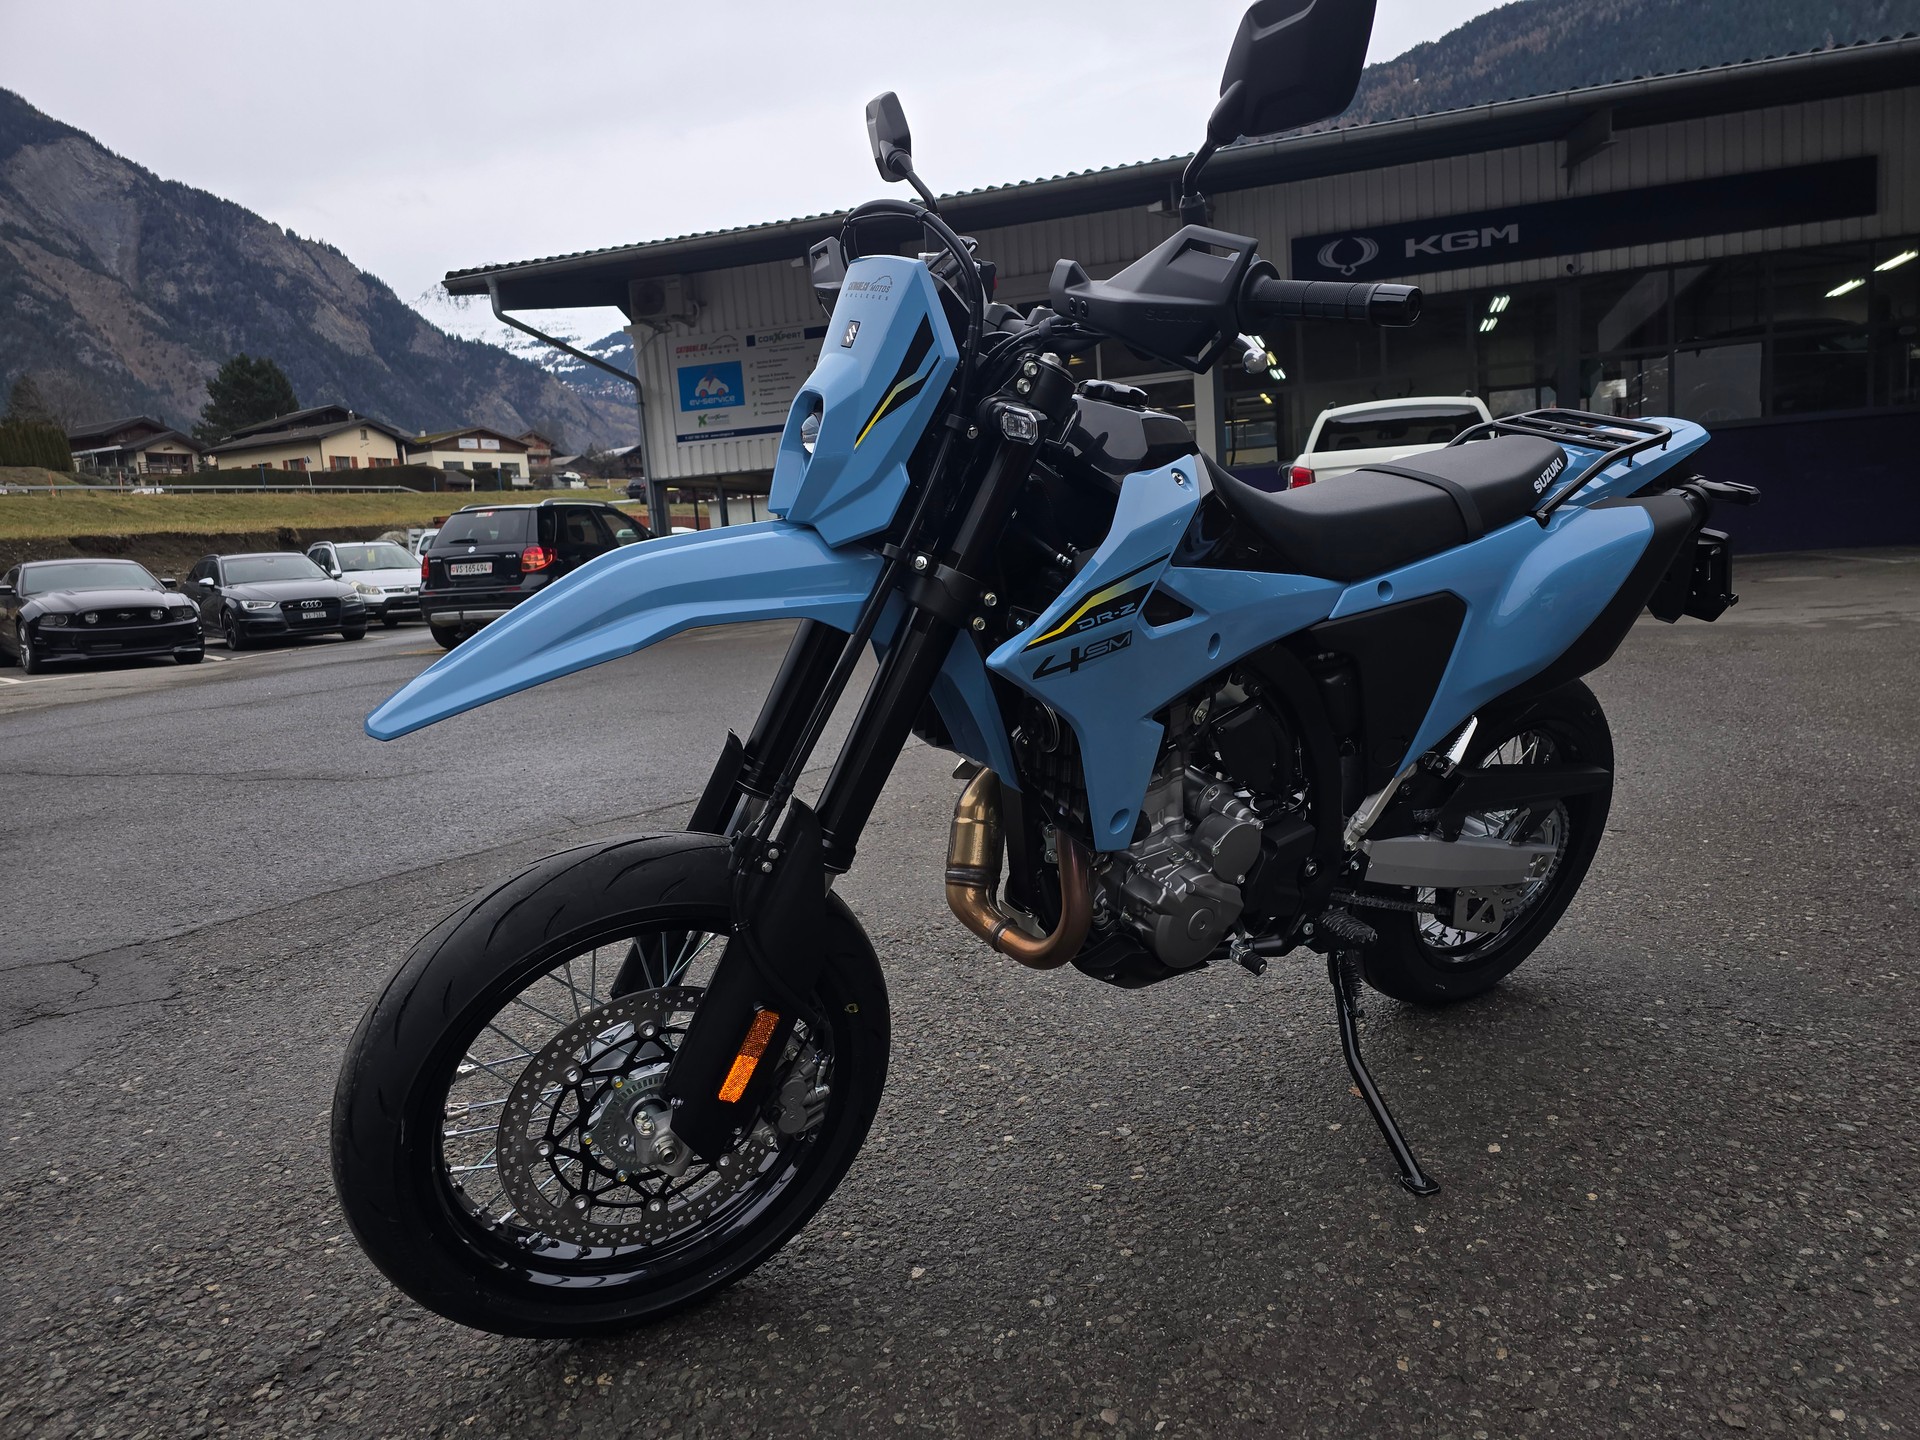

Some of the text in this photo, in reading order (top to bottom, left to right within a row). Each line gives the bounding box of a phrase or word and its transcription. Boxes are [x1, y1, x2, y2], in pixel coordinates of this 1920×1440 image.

[1405, 223, 1519, 258] KGM
[689, 395, 735, 406] ev-service
[1533, 457, 1564, 494] SUZUKI
[465, 563, 488, 573] 165494
[1077, 602, 1136, 631] DR-Z
